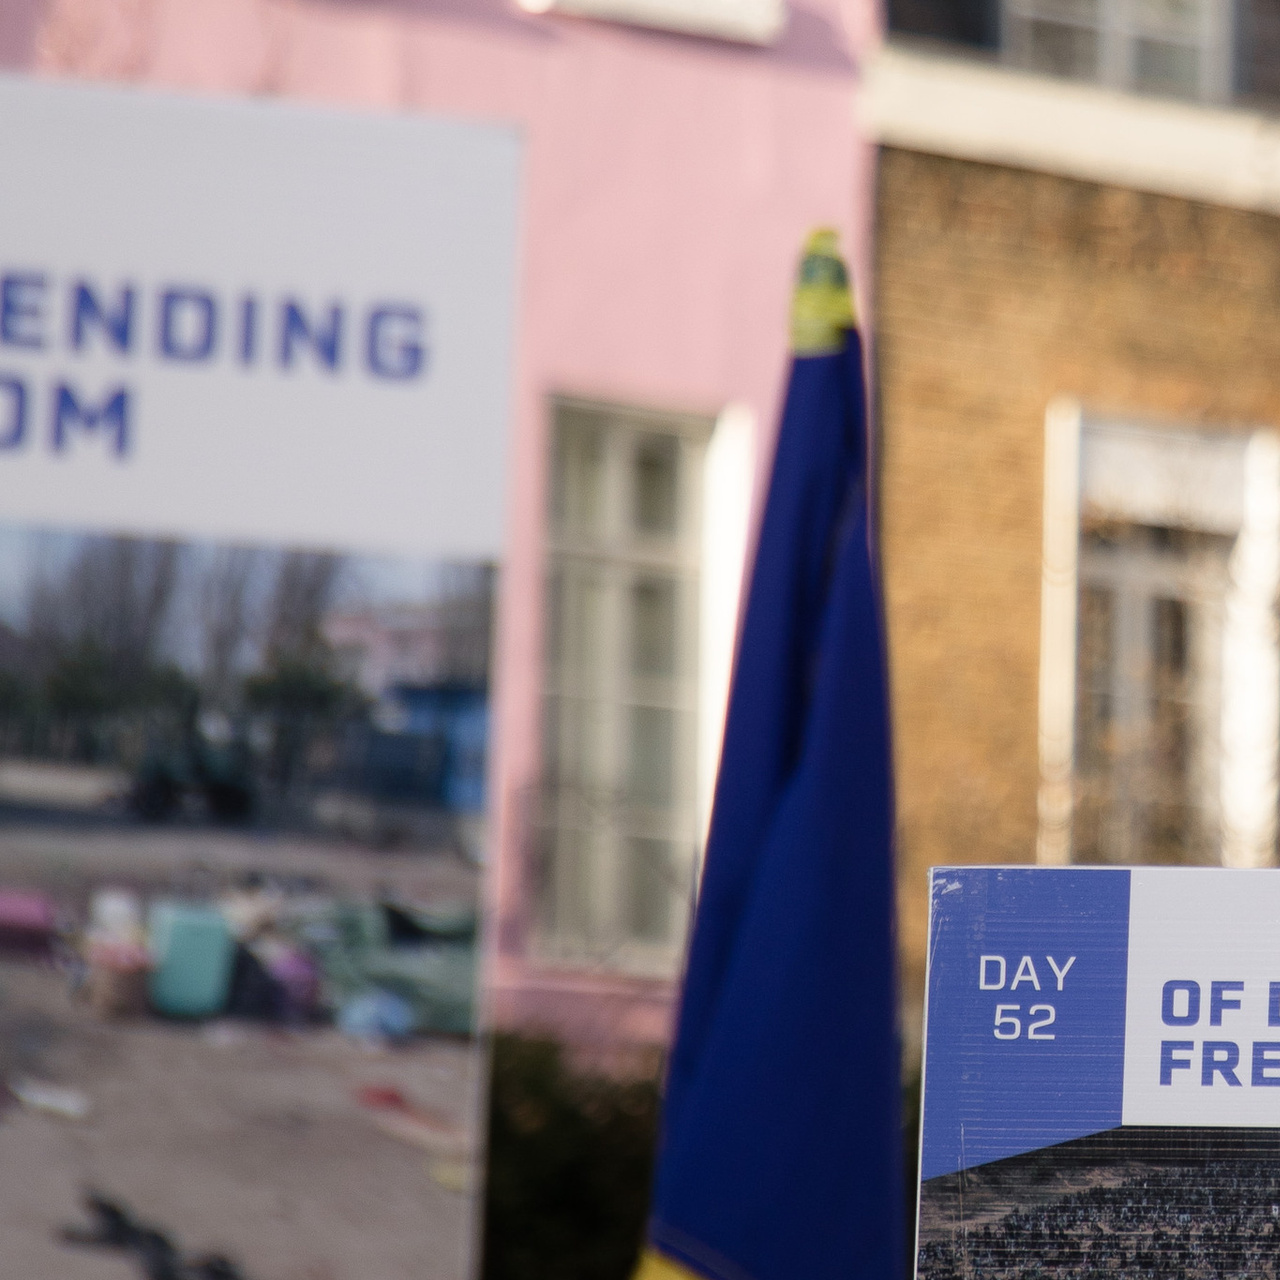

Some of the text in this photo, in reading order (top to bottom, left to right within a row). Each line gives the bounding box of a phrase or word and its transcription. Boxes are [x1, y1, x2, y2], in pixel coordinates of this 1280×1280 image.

[0, 273, 426, 381] ENDING
[979, 955, 1076, 991] DAY
[993, 1004, 1056, 1040] 52
[1161, 979, 1245, 1027] OF
